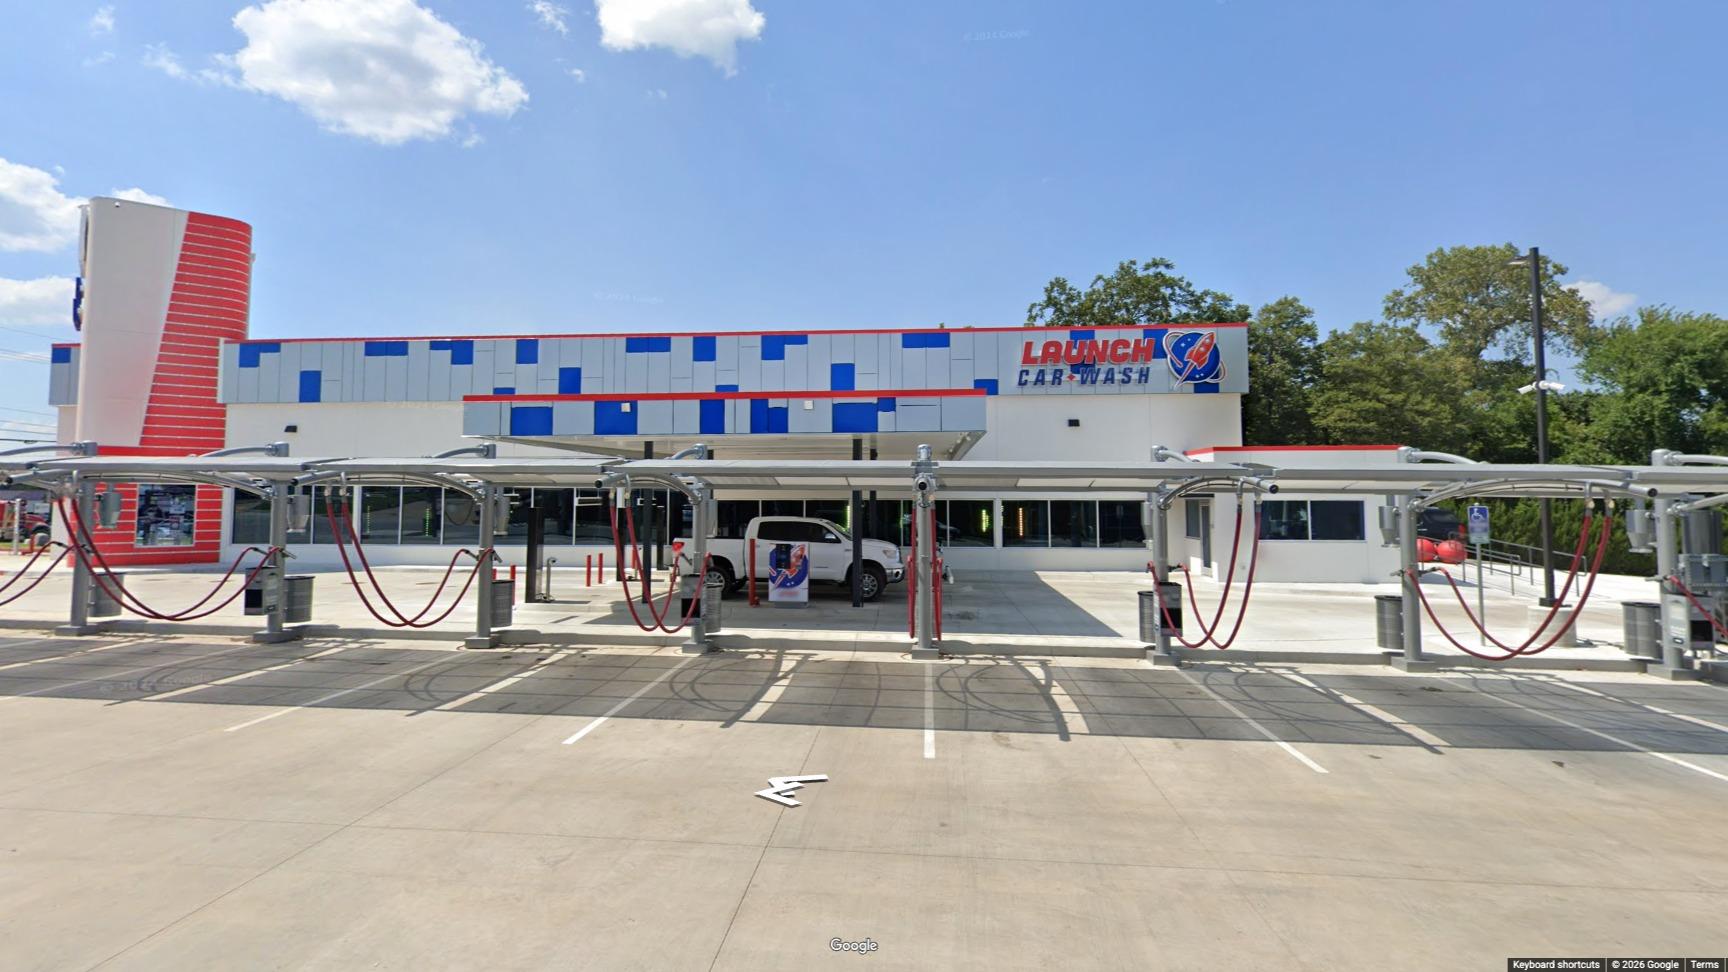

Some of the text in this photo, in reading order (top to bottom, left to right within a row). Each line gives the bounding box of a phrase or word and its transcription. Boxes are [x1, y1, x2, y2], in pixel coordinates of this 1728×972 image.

[1021, 338, 1156, 366] LAUNCH
[1017, 366, 1151, 387] CAR WASH
